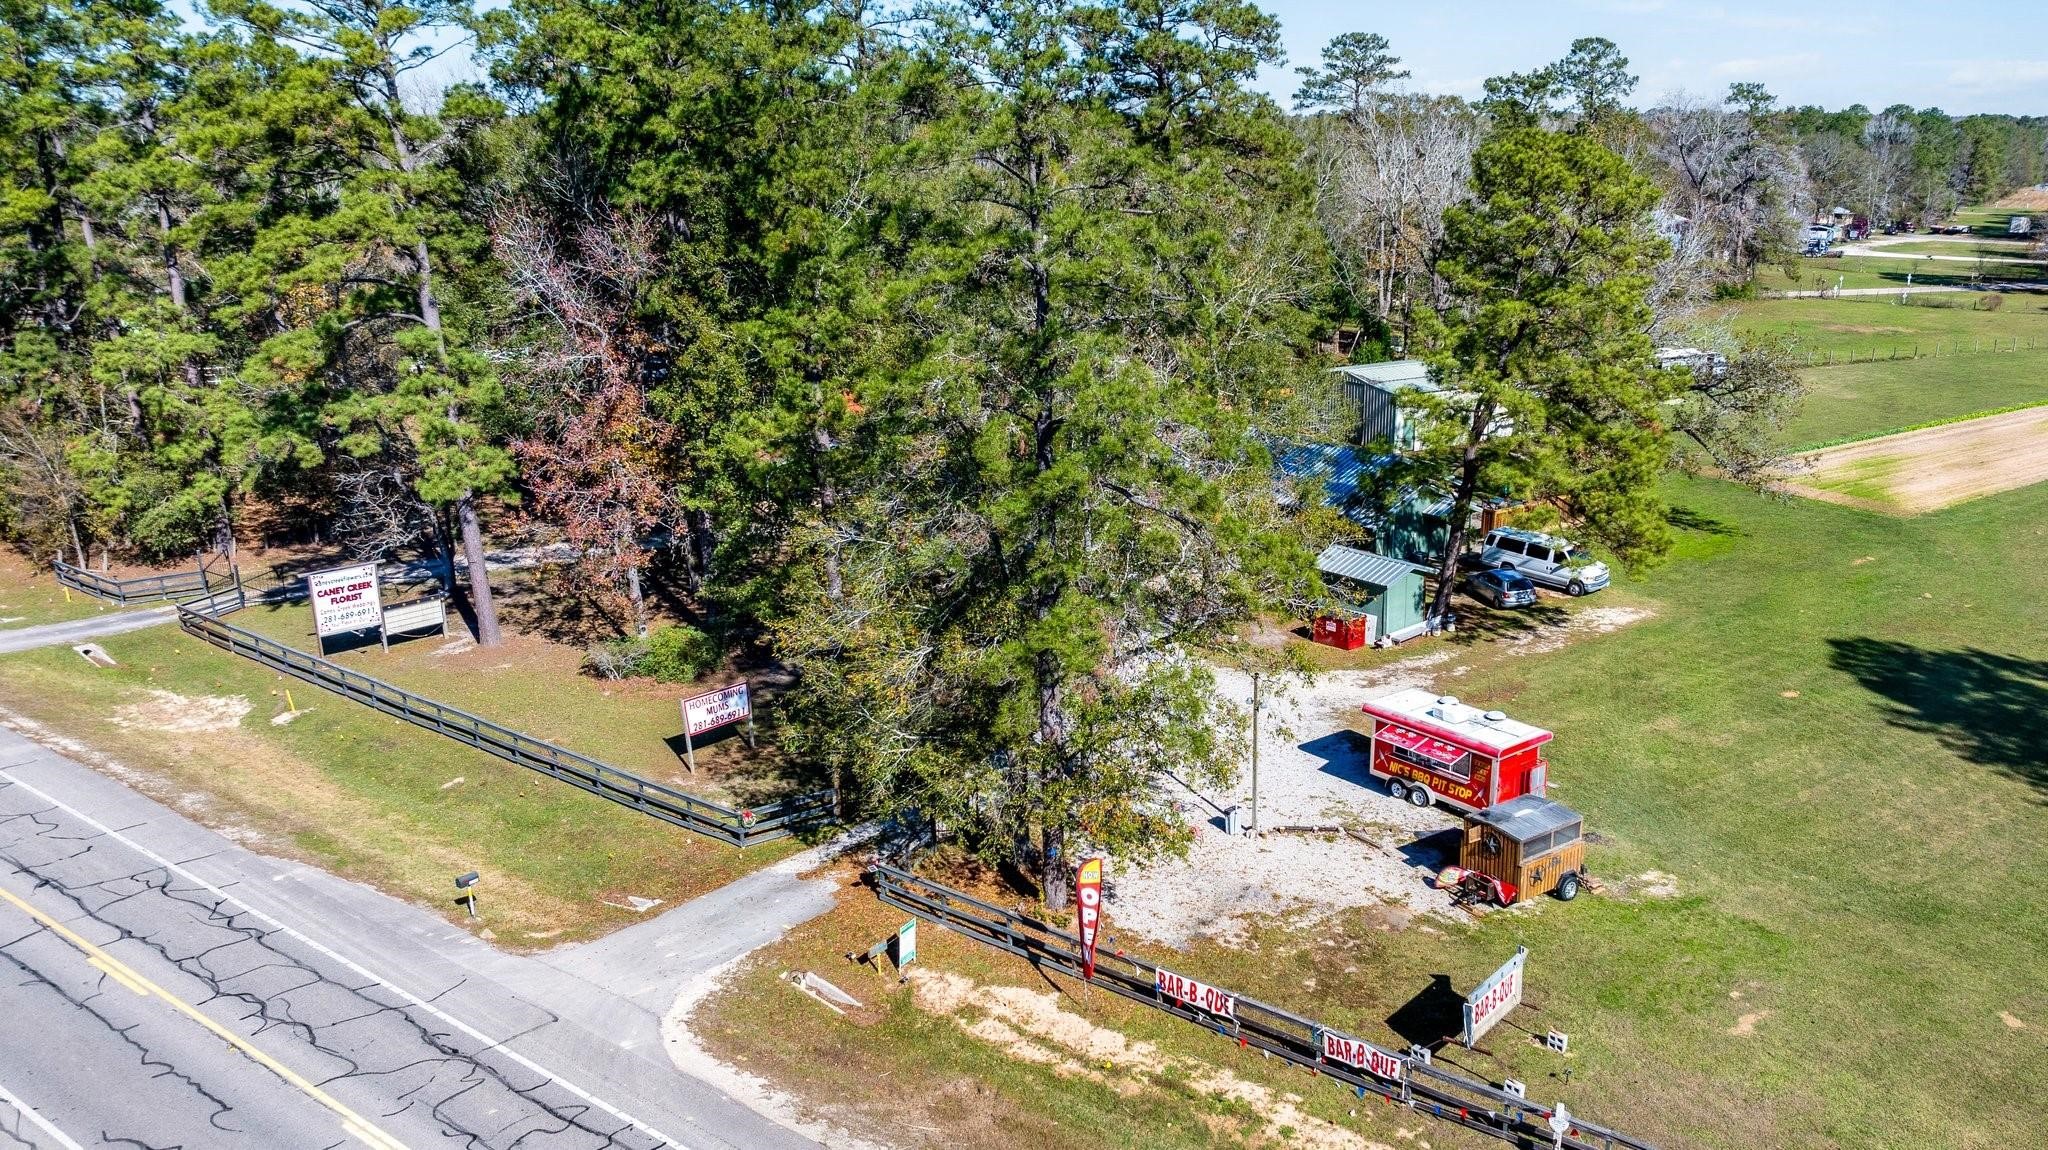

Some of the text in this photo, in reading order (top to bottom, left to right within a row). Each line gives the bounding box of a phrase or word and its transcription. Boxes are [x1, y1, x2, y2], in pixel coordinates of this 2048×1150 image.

[317, 581, 372, 598] CANEY CREEK
[331, 592, 362, 605] FLORIST
[324, 607, 375, 623] 281-689-6911
[689, 686, 744, 710] HOMECOMING
[706, 701, 730, 715] MUMS
[693, 707, 745, 731] 281-689-6911
[1389, 761, 1473, 800] NIC'S BBQ PIT STOP
[1080, 887, 1100, 966] OPEN
[1158, 971, 1230, 1015] BAR-B-QUE
[1474, 974, 1514, 1025] BAR-B-QUE
[1327, 1035, 1397, 1078] BAR-B-QUE
